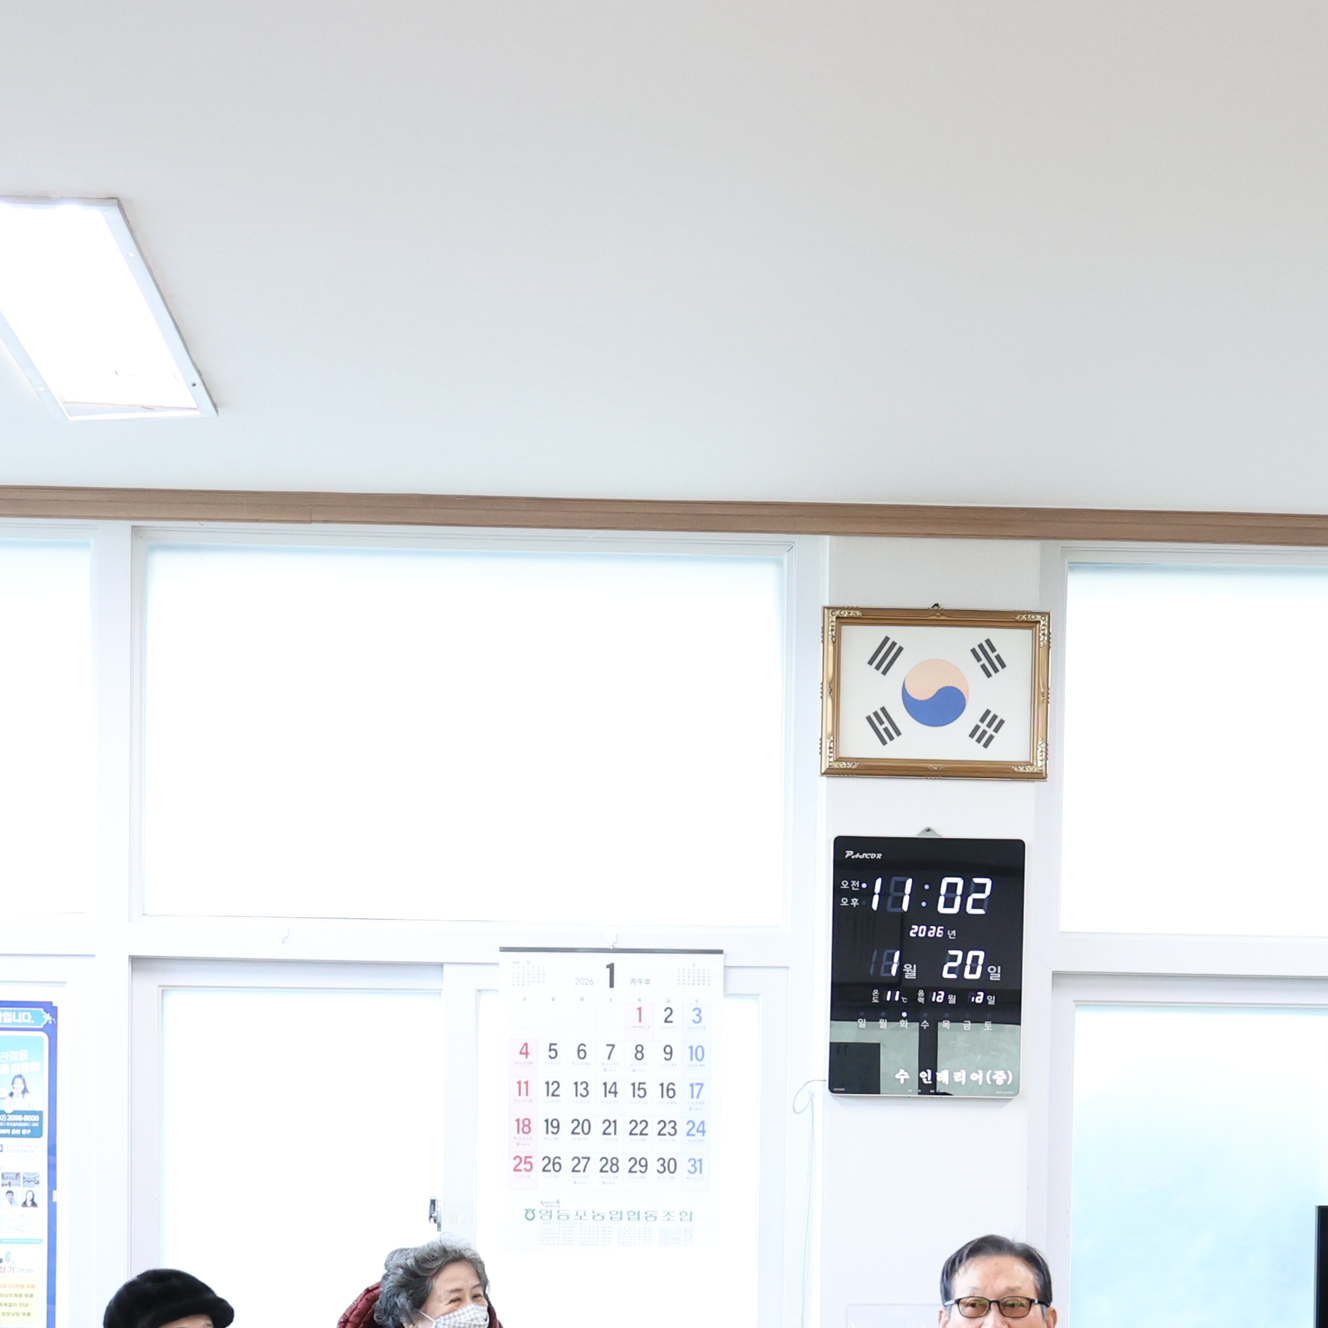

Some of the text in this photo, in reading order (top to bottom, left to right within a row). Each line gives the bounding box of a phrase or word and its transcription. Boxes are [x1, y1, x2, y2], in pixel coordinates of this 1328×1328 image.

[840, 880, 859, 890] 오전
[840, 897, 859, 908] 오후
[871, 876, 992, 914] 11:02
[910, 926, 956, 939] 2026 년
[903, 964, 916, 980] 월
[942, 950, 985, 979] 20
[988, 966, 1001, 980] 일
[575, 963, 614, 988] 2026 1
[987, 995, 995, 1005] 일
[636, 1006, 702, 1024] 1 2 3
[858, 1019, 992, 1031] 일 월 화 수 목 금 토
[518, 1042, 704, 1062] 4 5 6 7 8 9 10
[895, 1069, 910, 1085] 수
[516, 1080, 704, 1100] 11 12 13 14 15 16 17
[516, 1118, 706, 1136] 18 19 20 21 22 23 24
[512, 1156, 702, 1174] 25 26 27 28 29 30 31
[539, 1209, 694, 1222] 영등포농업협동조합
